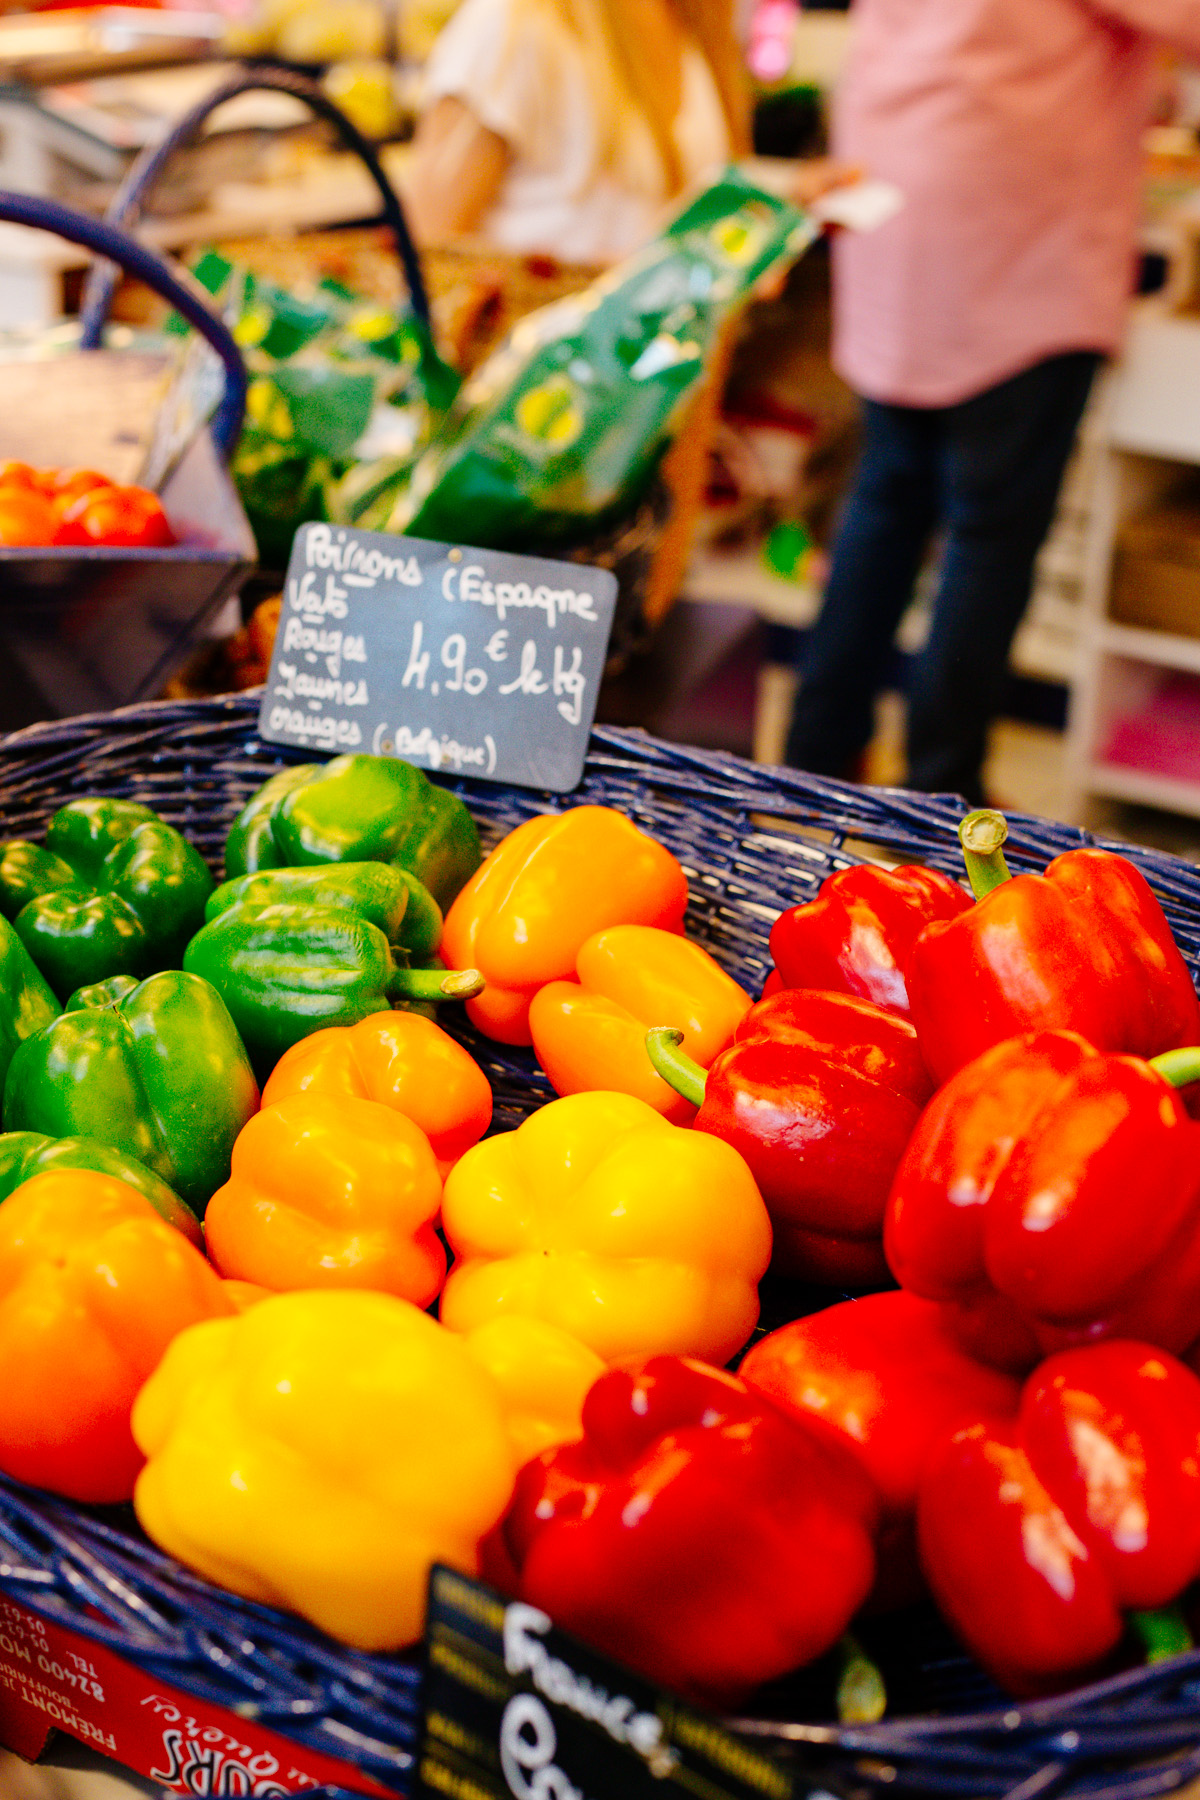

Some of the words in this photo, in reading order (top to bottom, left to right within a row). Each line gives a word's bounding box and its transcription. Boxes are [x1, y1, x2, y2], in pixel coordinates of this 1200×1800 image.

[283, 617, 367, 678] Rouges
[499, 640, 549, 694] le
[274, 661, 369, 705] Jaunes
[37, 1654, 106, 1703] 82400
[66, 1651, 99, 1679] TEL.
[21, 1686, 117, 1751] FRÉMONT
